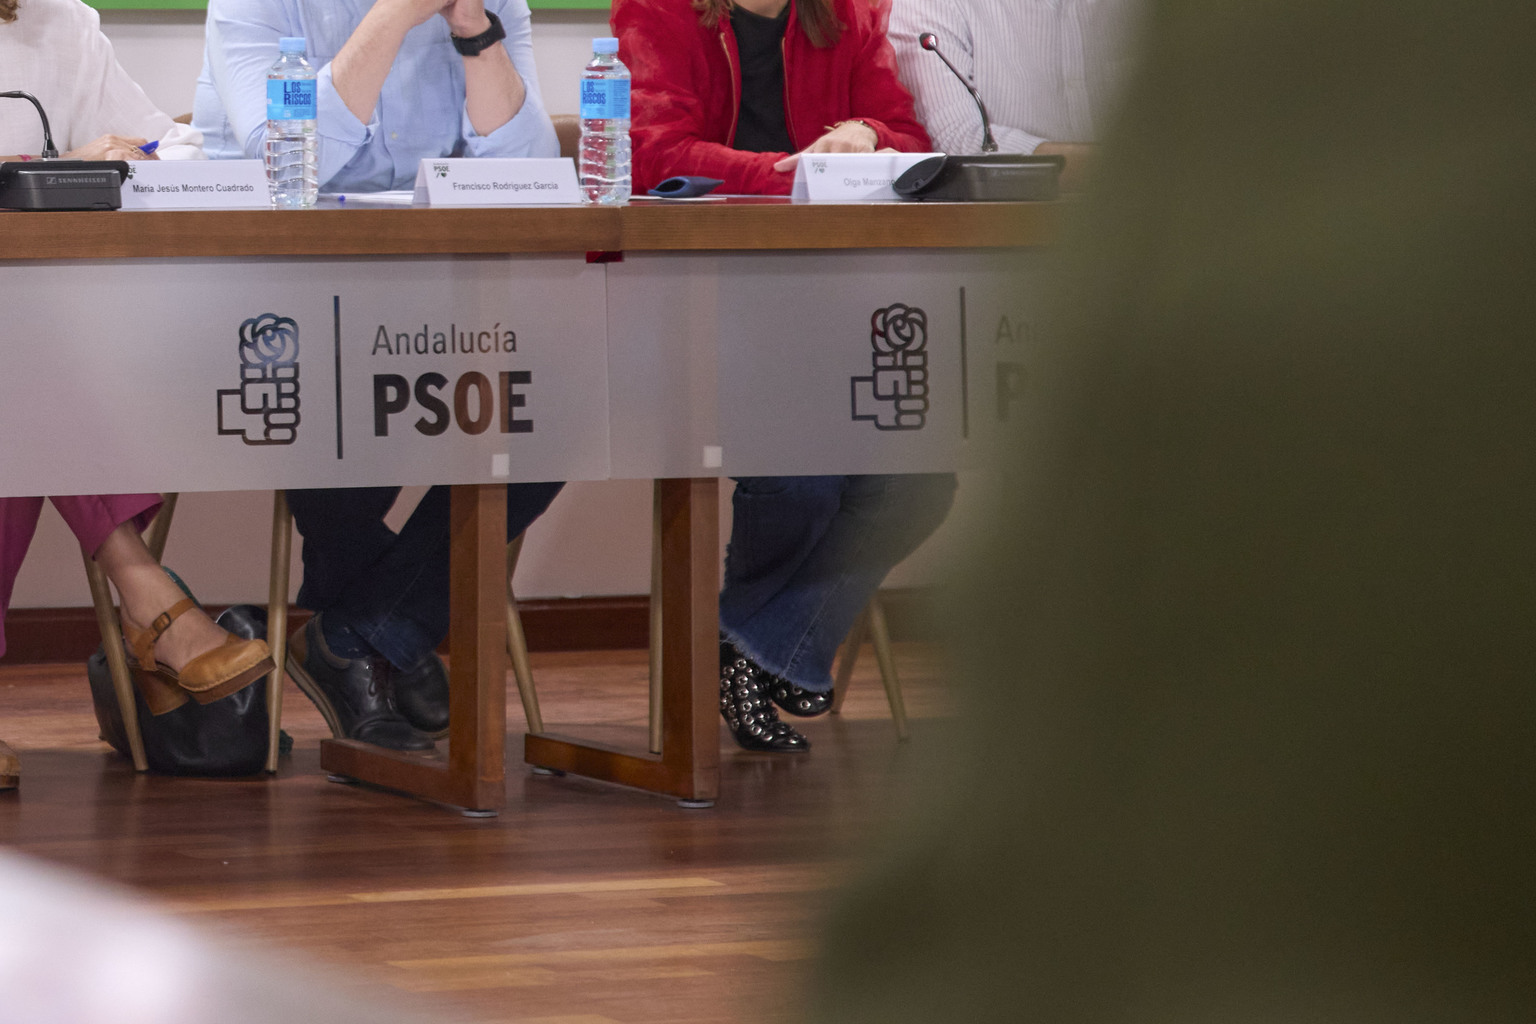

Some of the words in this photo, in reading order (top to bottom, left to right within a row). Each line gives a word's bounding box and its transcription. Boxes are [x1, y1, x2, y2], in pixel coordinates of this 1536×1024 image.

[283, 81, 301, 93] LOS
[283, 93, 311, 105] RISCOS
[182, 183, 214, 193] Montero
[216, 183, 254, 192] Cuadrado
[452, 182, 491, 190] Francisco
[370, 322, 518, 356] Andalucía
[373, 370, 534, 437] PSOE
